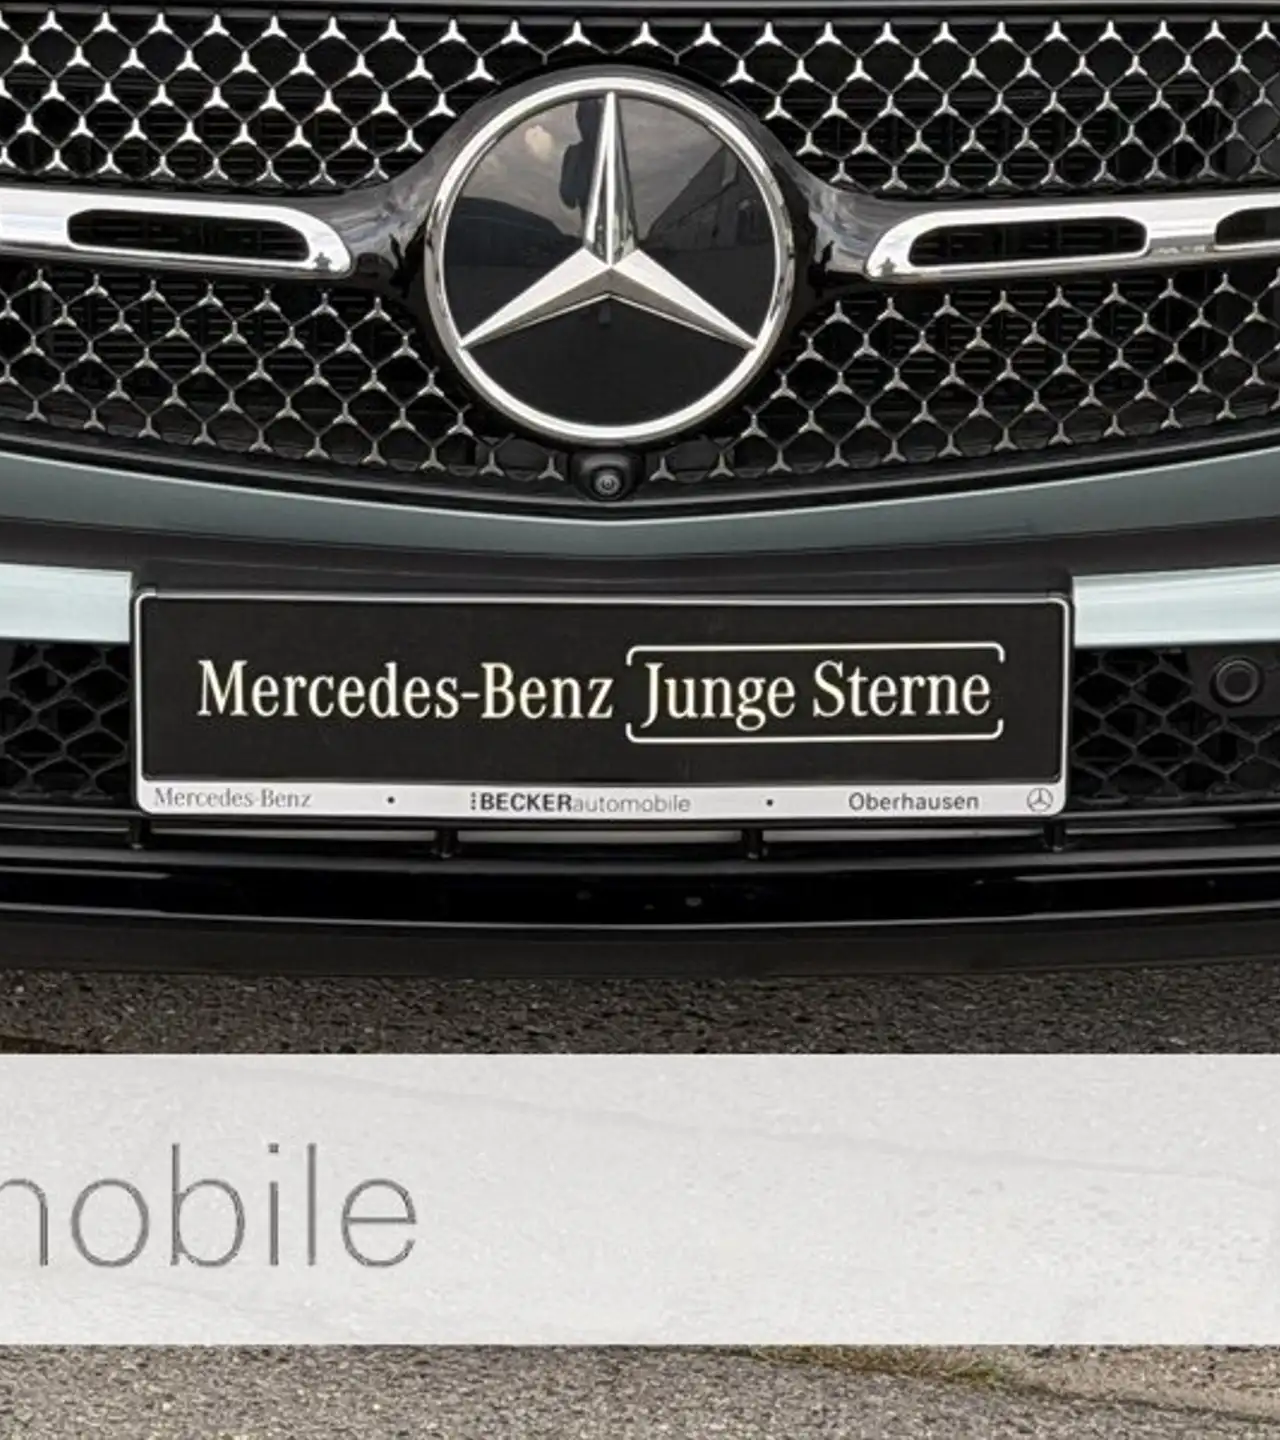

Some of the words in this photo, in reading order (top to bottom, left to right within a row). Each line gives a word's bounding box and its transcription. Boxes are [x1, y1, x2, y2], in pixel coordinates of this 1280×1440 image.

[197, 659, 614, 720] Mercedes-Benz
[640, 662, 797, 732] Junge
[812, 660, 992, 718] Sterne
[154, 787, 312, 809] Mercedes-Benz
[848, 791, 980, 812] Oberhausen
